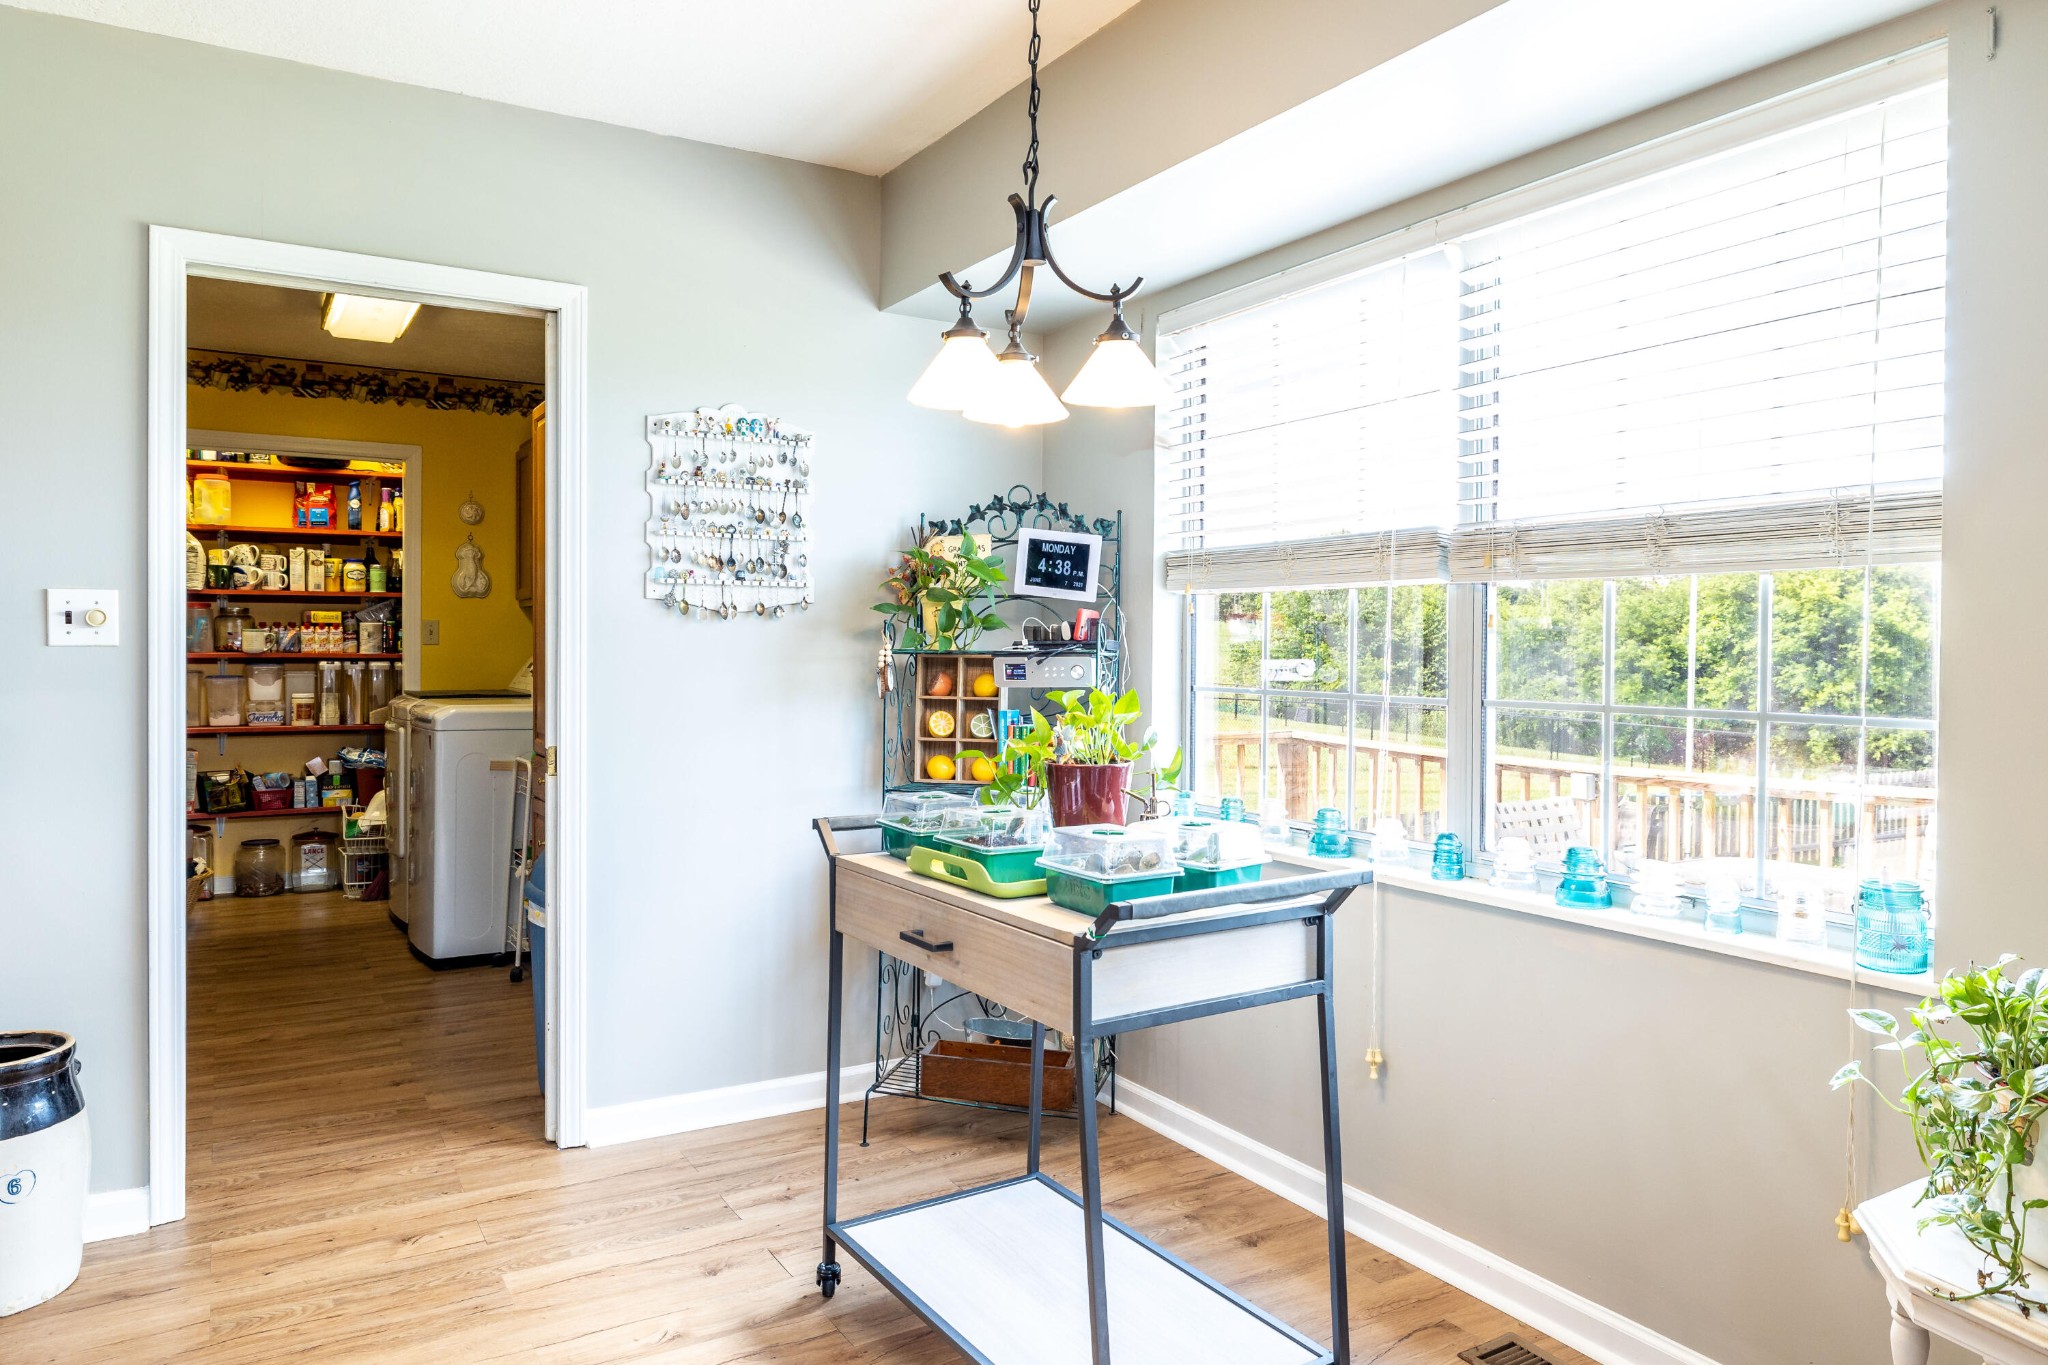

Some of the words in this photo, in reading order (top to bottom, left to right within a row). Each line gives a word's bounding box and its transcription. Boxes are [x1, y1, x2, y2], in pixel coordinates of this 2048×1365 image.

[1041, 542, 1076, 555] MONDAY
[1037, 557, 1072, 576] 4:38
[1072, 570, 1085, 578] P.M.
[303, 847, 325, 855] LANCE
[7, 1177, 22, 1196] 6
